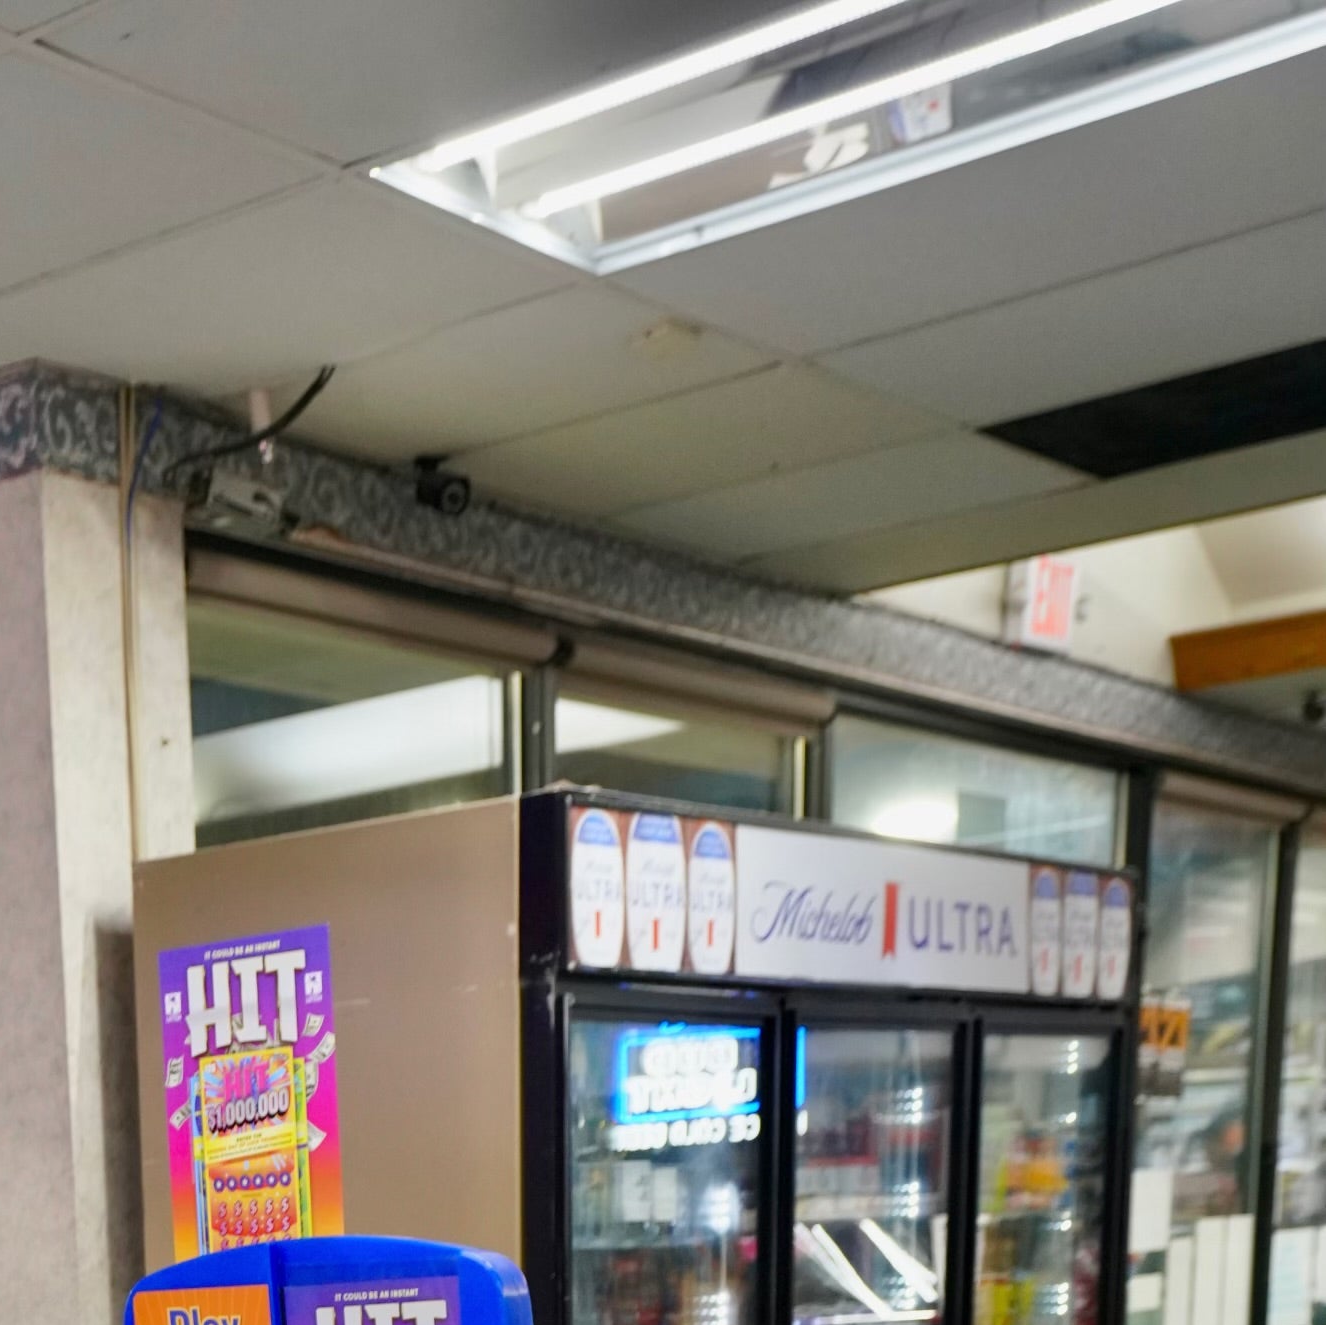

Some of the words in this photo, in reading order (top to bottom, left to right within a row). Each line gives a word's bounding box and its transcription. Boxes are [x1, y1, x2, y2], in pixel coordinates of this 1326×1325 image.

[751, 880, 879, 946] Michelob
[908, 895, 1018, 958] ULTRA
[185, 949, 306, 1057] HIT
[224, 1061, 270, 1102] HIT
[334, 1293, 342, 1302] IT
[343, 1291, 368, 1301] COULD
[368, 1290, 378, 1300] BE
[379, 1289, 390, 1299] AN
[390, 1287, 419, 1298] INSTANT
